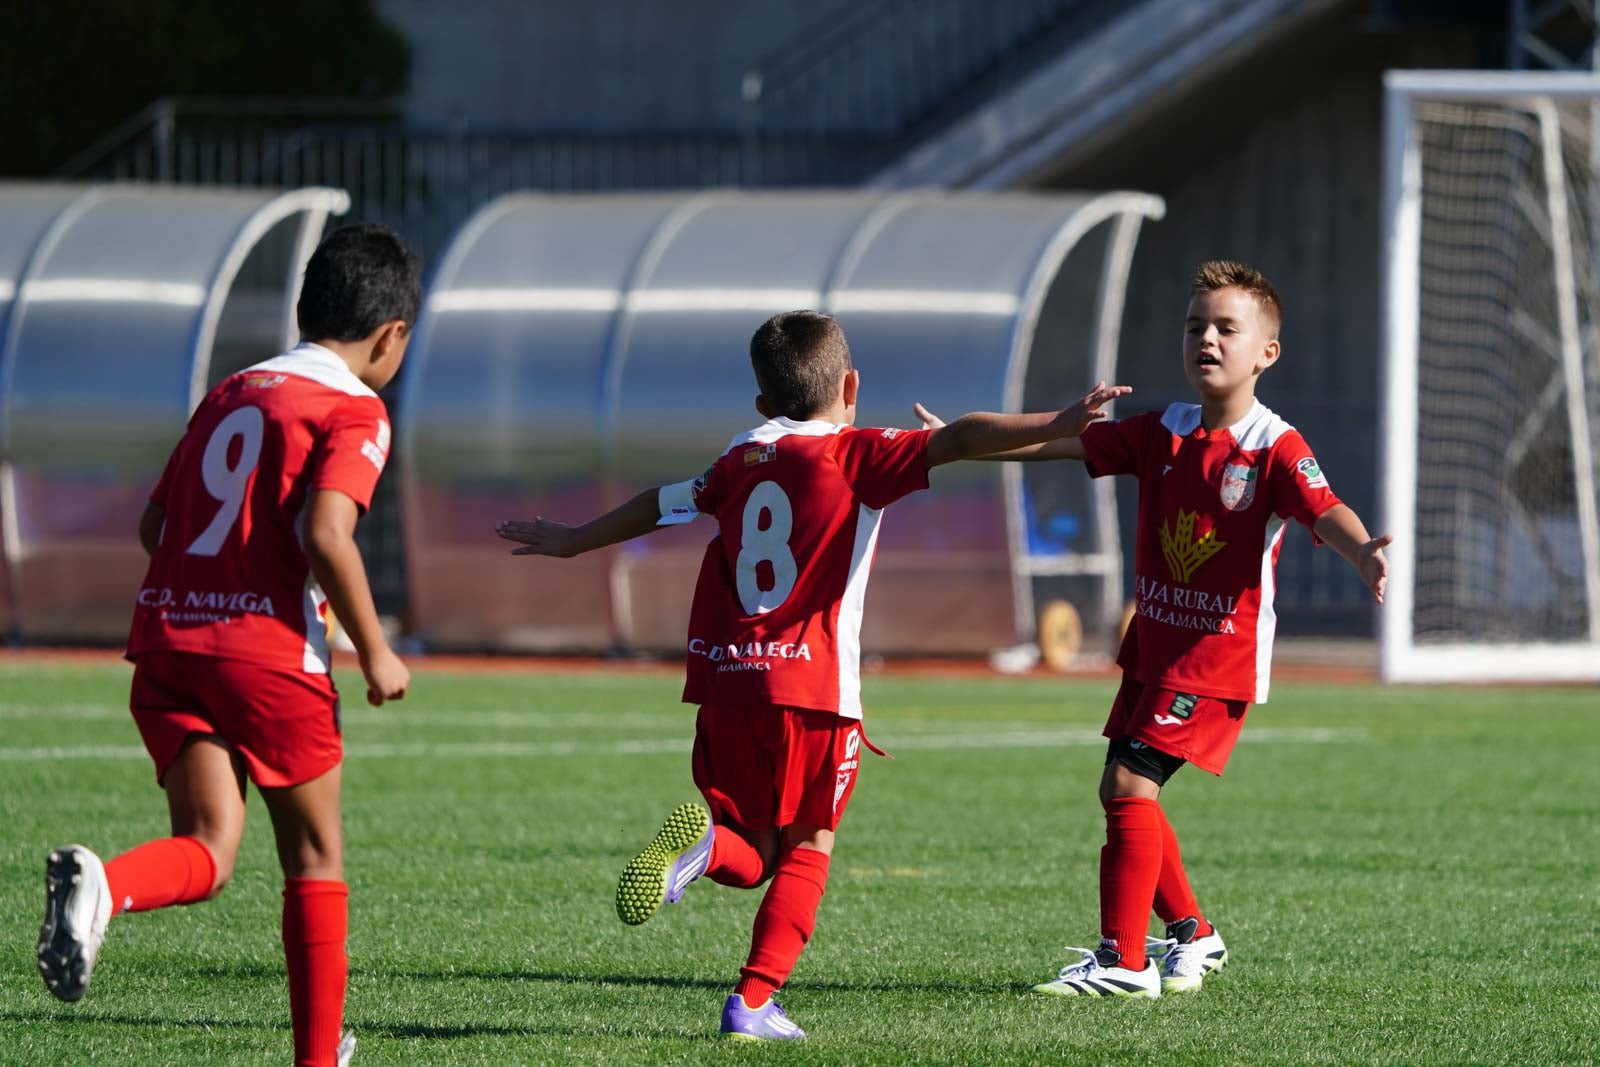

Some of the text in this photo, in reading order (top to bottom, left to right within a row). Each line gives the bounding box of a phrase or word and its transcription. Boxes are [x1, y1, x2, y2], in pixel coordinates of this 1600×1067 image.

[187, 406, 264, 555] 9
[736, 481, 797, 614] 8
[1136, 574, 1237, 614] AJA RURAL
[1139, 602, 1235, 634] SALAMANCA
[728, 641, 811, 661] NAVEGA
